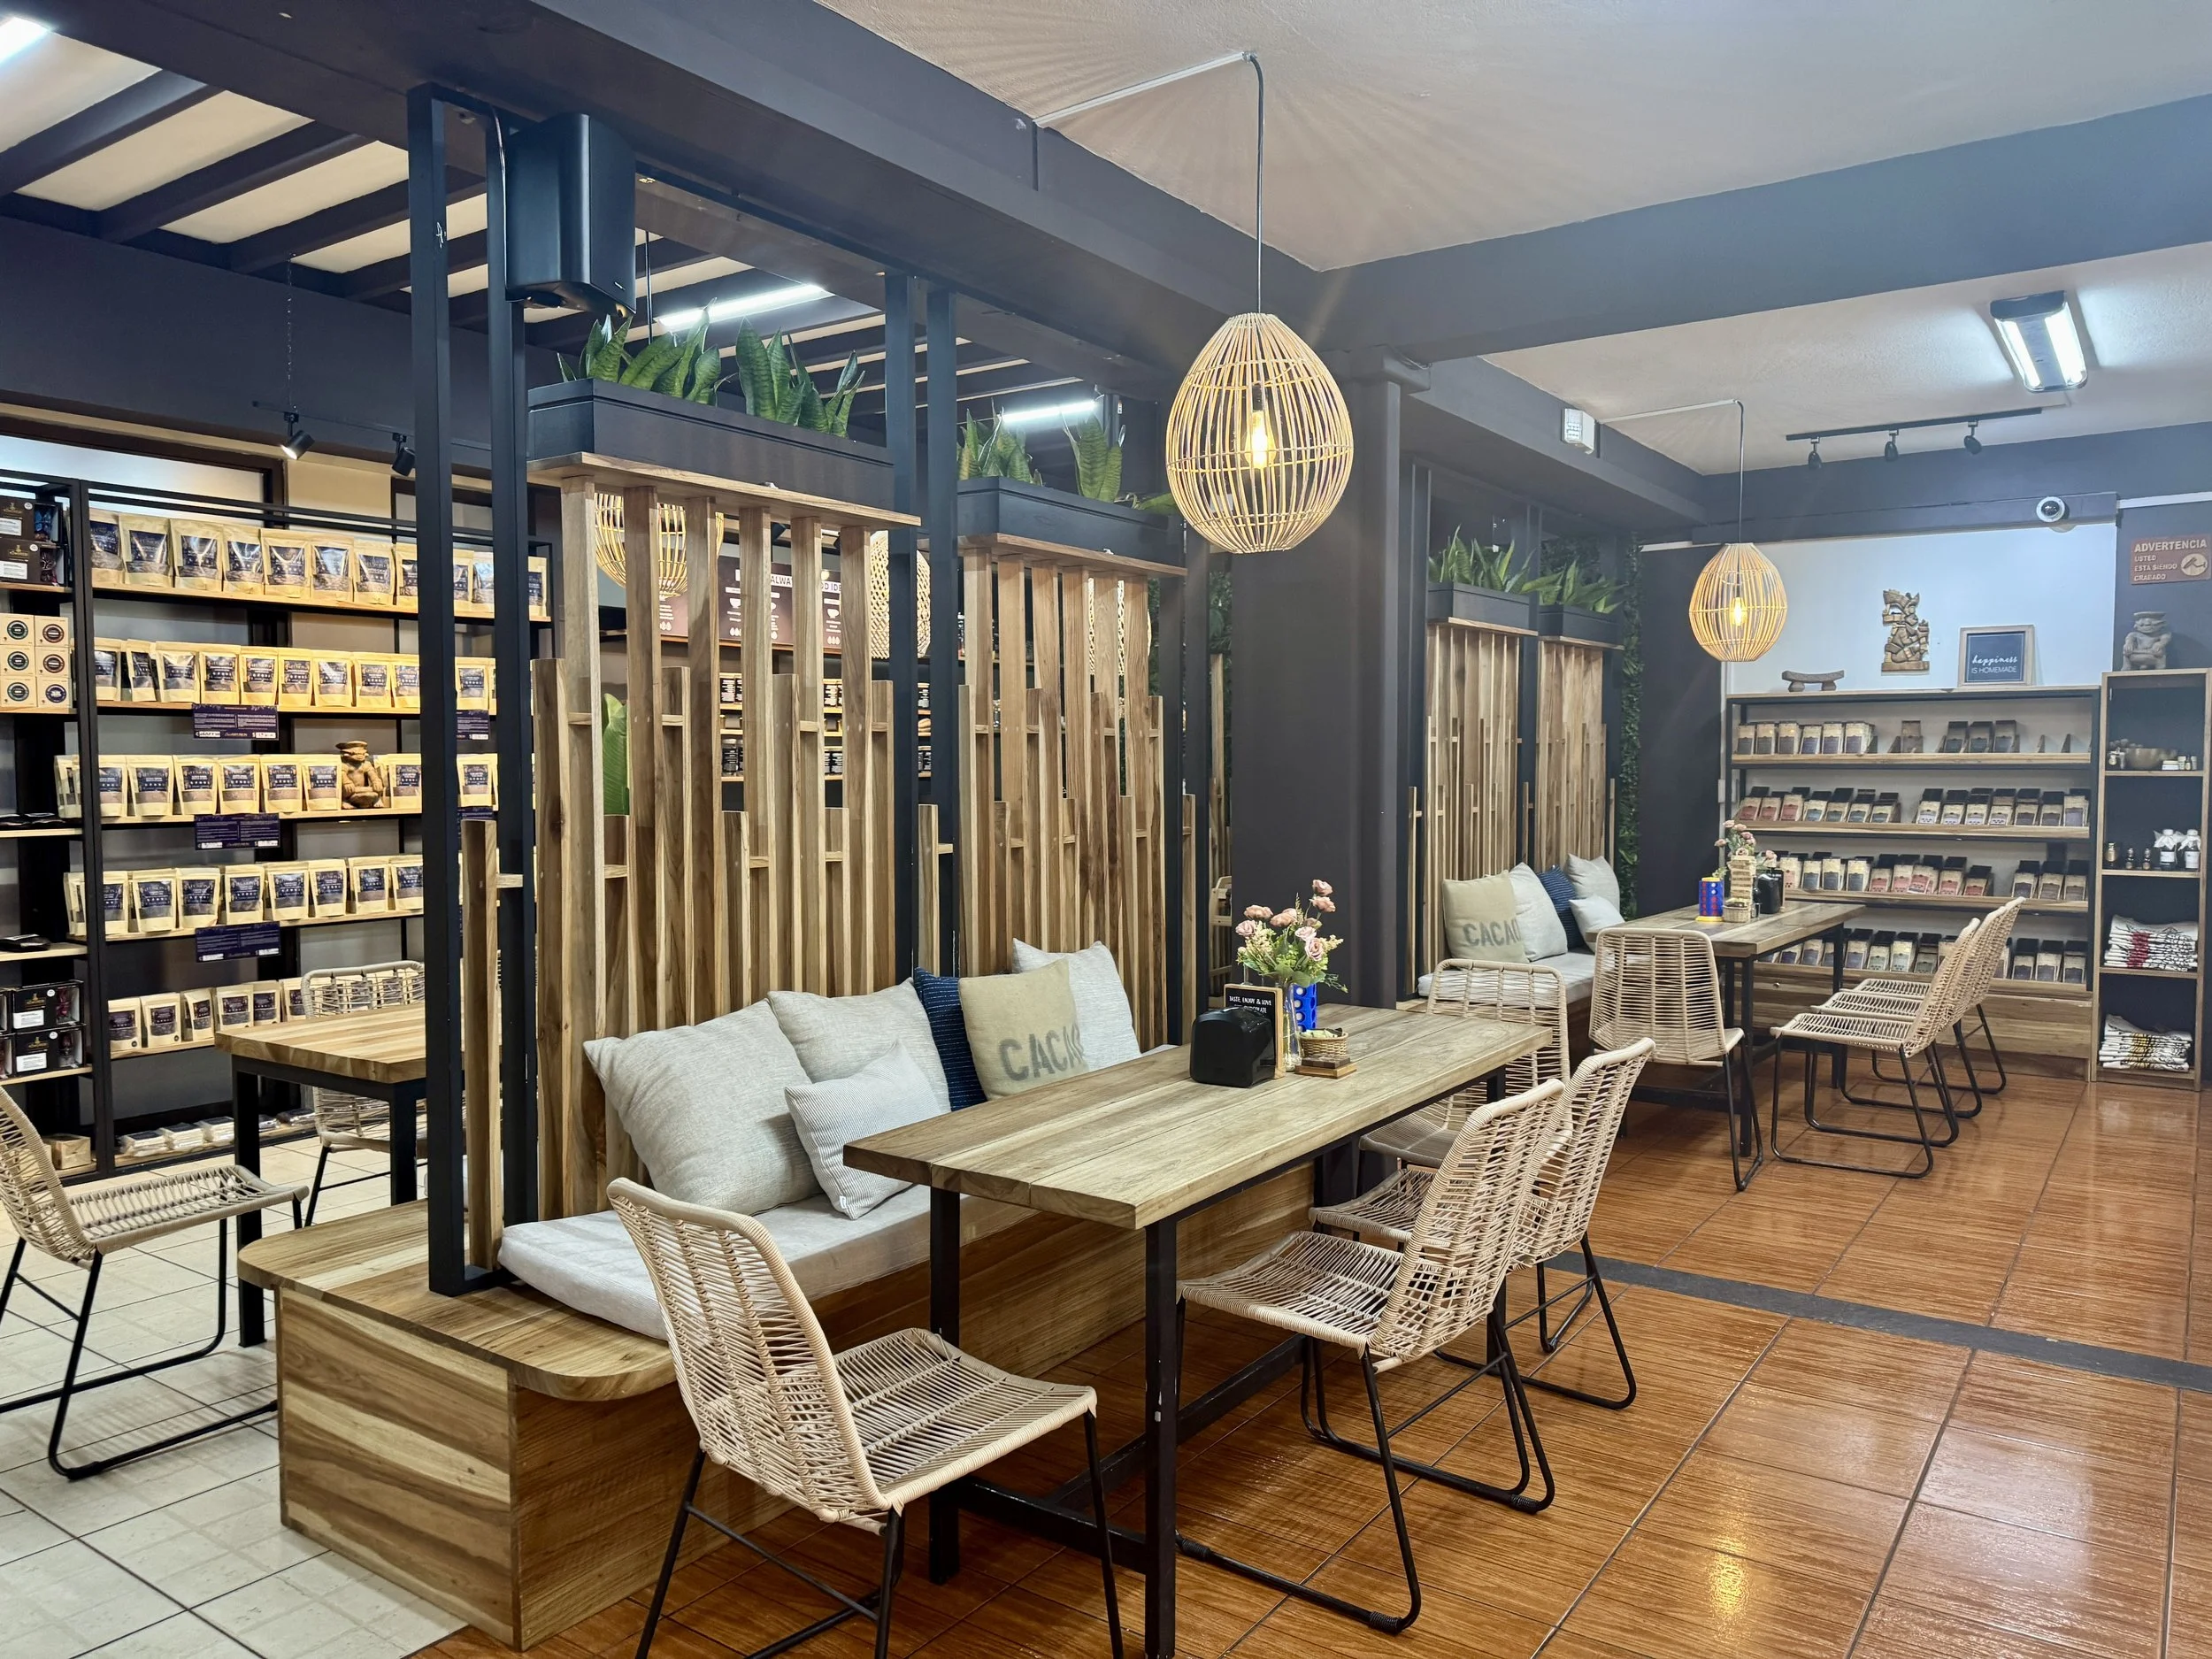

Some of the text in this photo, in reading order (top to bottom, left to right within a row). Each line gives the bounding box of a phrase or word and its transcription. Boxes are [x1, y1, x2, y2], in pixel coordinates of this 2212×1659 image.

[2134, 539, 2208, 553] ADVERTENCIA
[2153, 563, 2177, 572] SIENDO
[771, 575, 792, 585] ALWA
[1972, 655, 2018, 666] happiness
